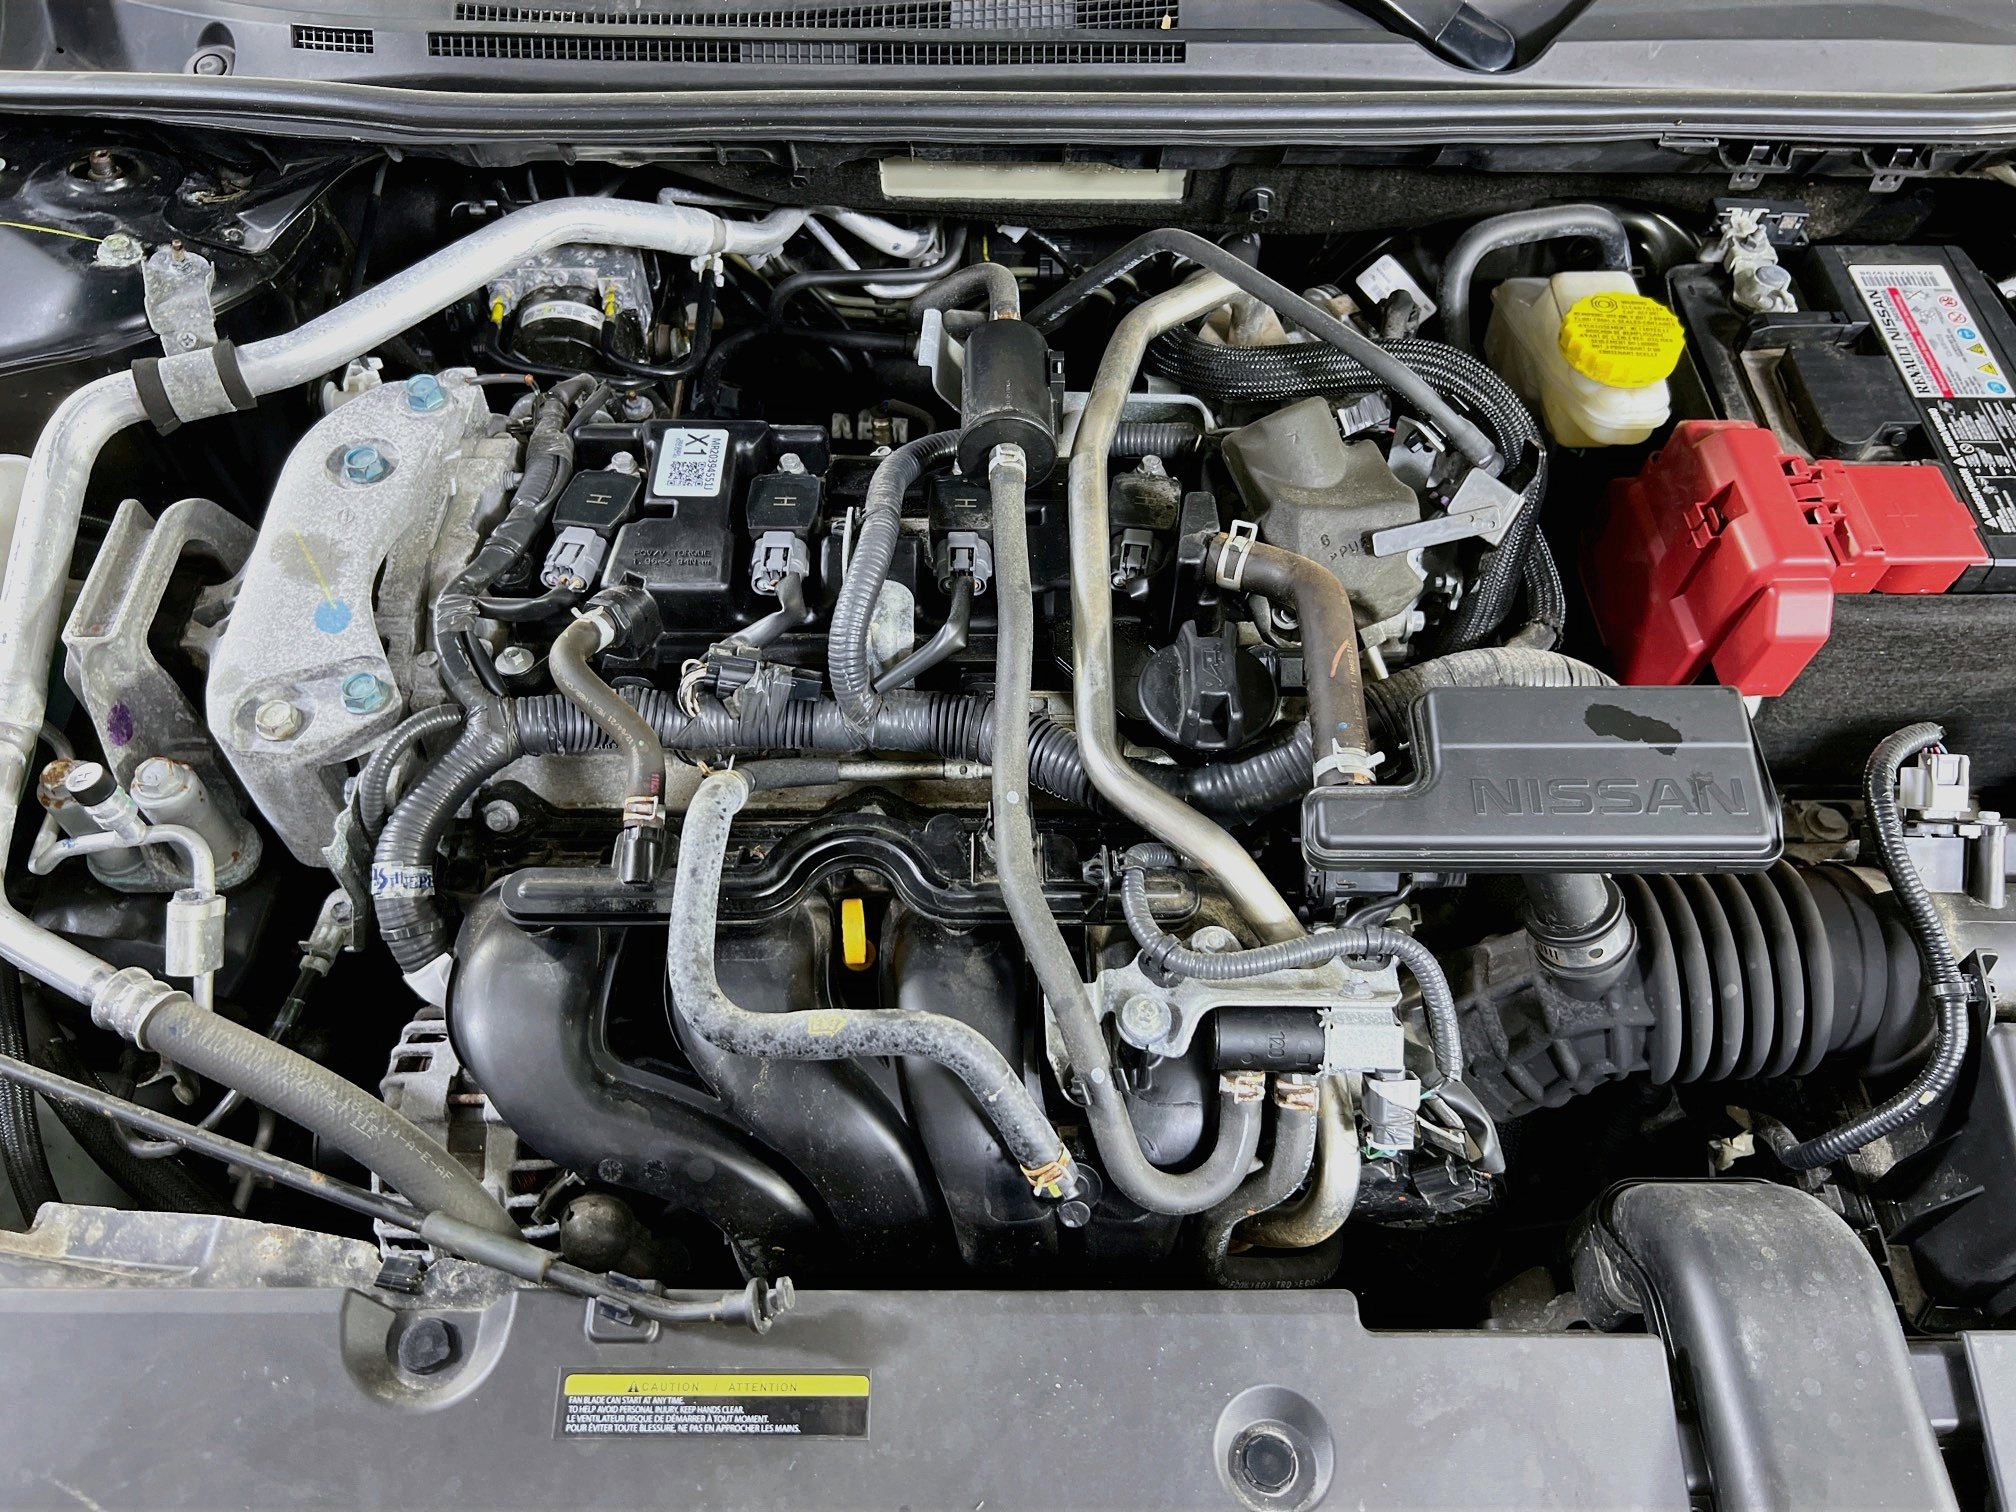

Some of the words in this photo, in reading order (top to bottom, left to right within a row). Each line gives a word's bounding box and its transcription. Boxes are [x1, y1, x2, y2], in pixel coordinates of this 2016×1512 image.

[1866, 289, 1903, 341] NISSAN
[1894, 344, 1930, 394] RENAULT
[683, 433, 710, 455] X1
[1470, 777, 1750, 815] NISSAN
[642, 1383, 699, 1392] CAUTION
[728, 1383, 798, 1392] ATTENTION
[568, 1396, 583, 1405] FAN
[583, 1396, 606, 1405] BLADE
[606, 1396, 621, 1405] CAN
[621, 1396, 642, 1405] START
[642, 1396, 651, 1405] AT
[568, 1405, 579, 1414] TO
[579, 1405, 596, 1414] HELP
[596, 1405, 618, 1414] AVOID
[619, 1405, 654, 1414] PERSONAL
[680, 1405, 696, 1414] KEEP
[697, 1405, 721, 1414] HANDS
[566, 1414, 576, 1423] LE
[576, 1414, 625, 1423] VENTILATEUR
[626, 1414, 653, 1423] RISQUE
[654, 1414, 665, 1423] DE
[665, 1413, 705, 1423] DÉMARRER
[706, 1413, 713, 1423] À
[713, 1414, 734, 1423] TOUT
[734, 1414, 769, 1423] MOMENT.
[565, 1424, 587, 1433] POUR
[588, 1422, 613, 1433] ÉVITER
[613, 1424, 638, 1433] TOUTE
[677, 1424, 688, 1433] NE
[689, 1424, 704, 1433] PAS
[704, 1424, 714, 1433] EN
[715, 1424, 760, 1433] APPROCHER
[760, 1424, 774, 1433] LES
[774, 1424, 801, 1433] MAINS.
